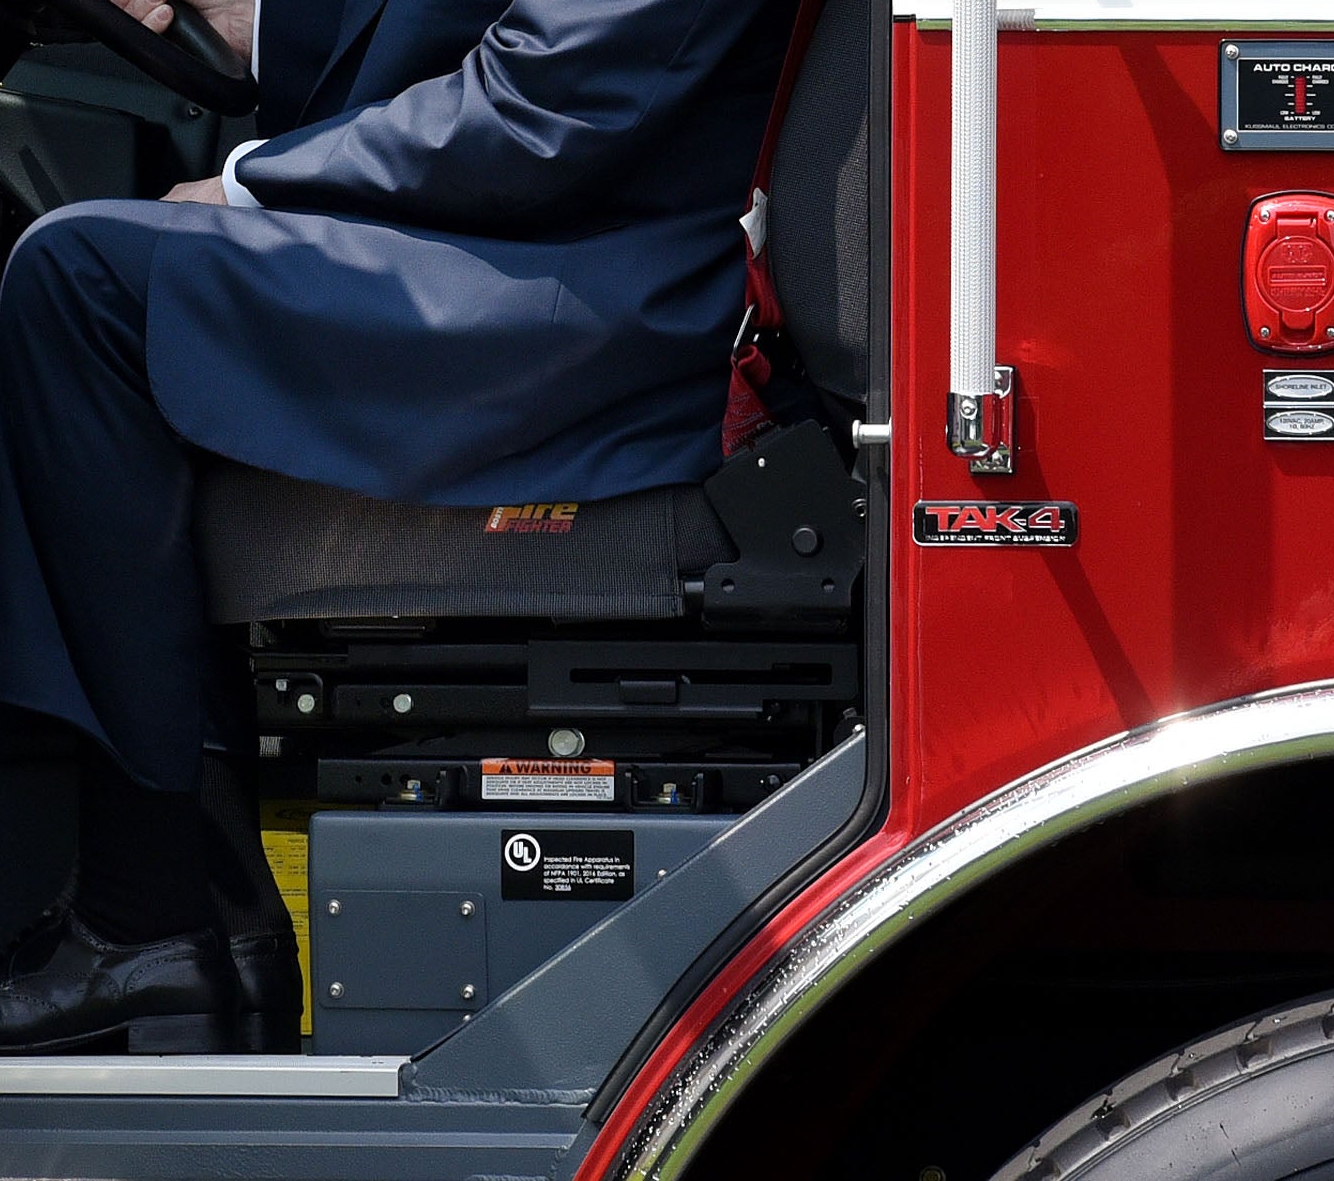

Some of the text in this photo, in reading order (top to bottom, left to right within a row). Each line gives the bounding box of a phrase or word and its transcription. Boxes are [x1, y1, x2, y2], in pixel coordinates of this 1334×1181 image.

[1253, 63, 1291, 72] AUTO
[925, 506, 1066, 533] TAK-4
[516, 761, 592, 774] WARNING
[513, 841, 533, 864] UL
